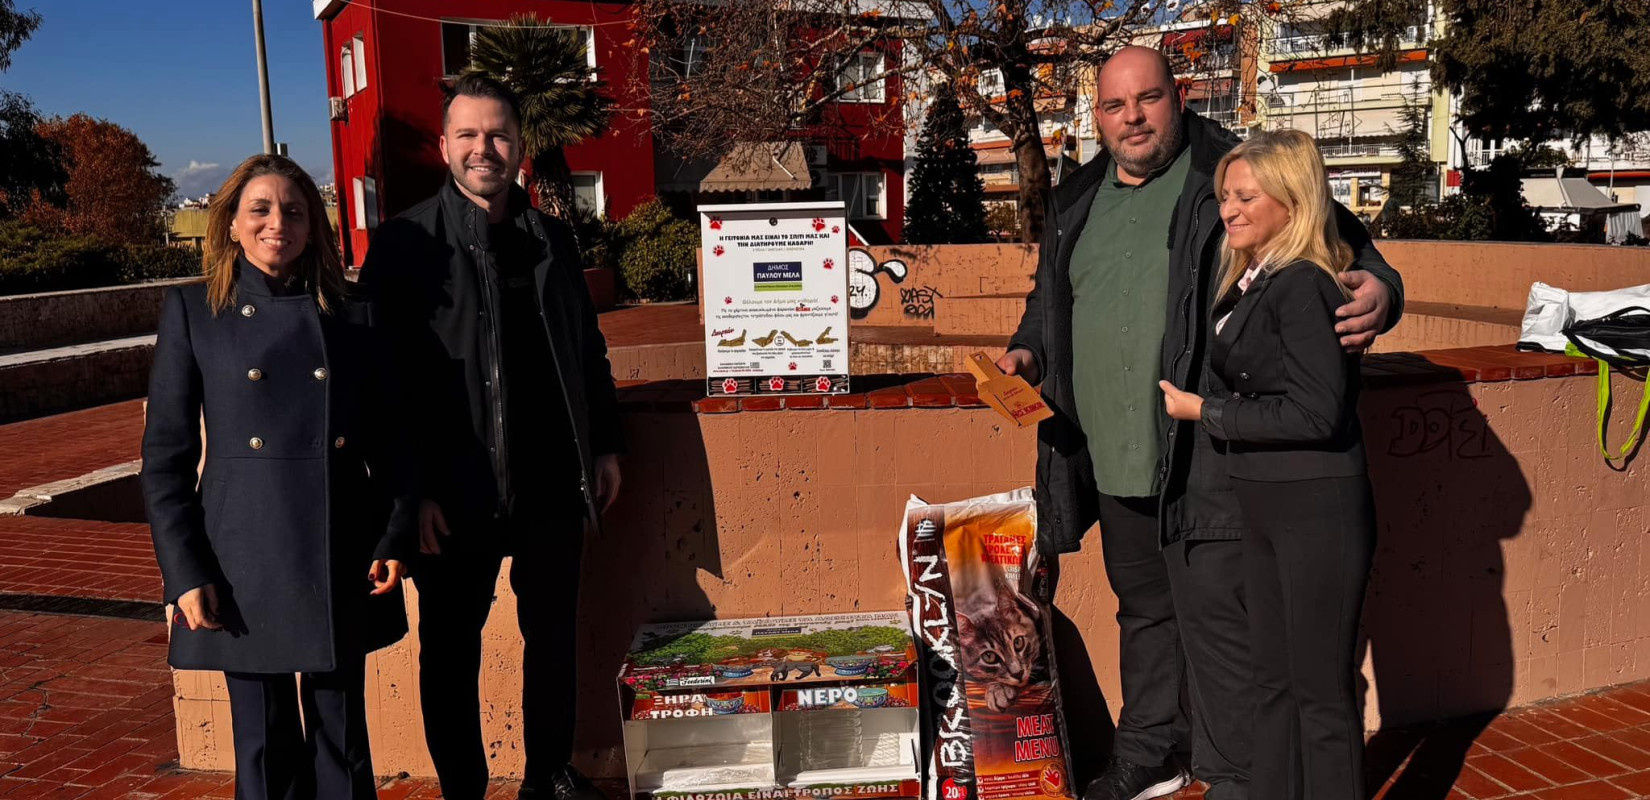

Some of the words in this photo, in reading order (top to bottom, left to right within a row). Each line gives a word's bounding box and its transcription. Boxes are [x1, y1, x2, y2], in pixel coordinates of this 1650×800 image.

[911, 554, 974, 768] BROOKLYN
[650, 707, 713, 719] ΤΡΟΦΗ
[1016, 713, 1054, 738] MEAT
[1014, 735, 1060, 762] MENU
[748, 789, 788, 800] ΕΙΝΑΙ
[793, 786, 853, 797] ΤΡΟΠΟΣ
[857, 784, 898, 793] ΖΩΗΣ
[945, 786, 959, 799] 20
